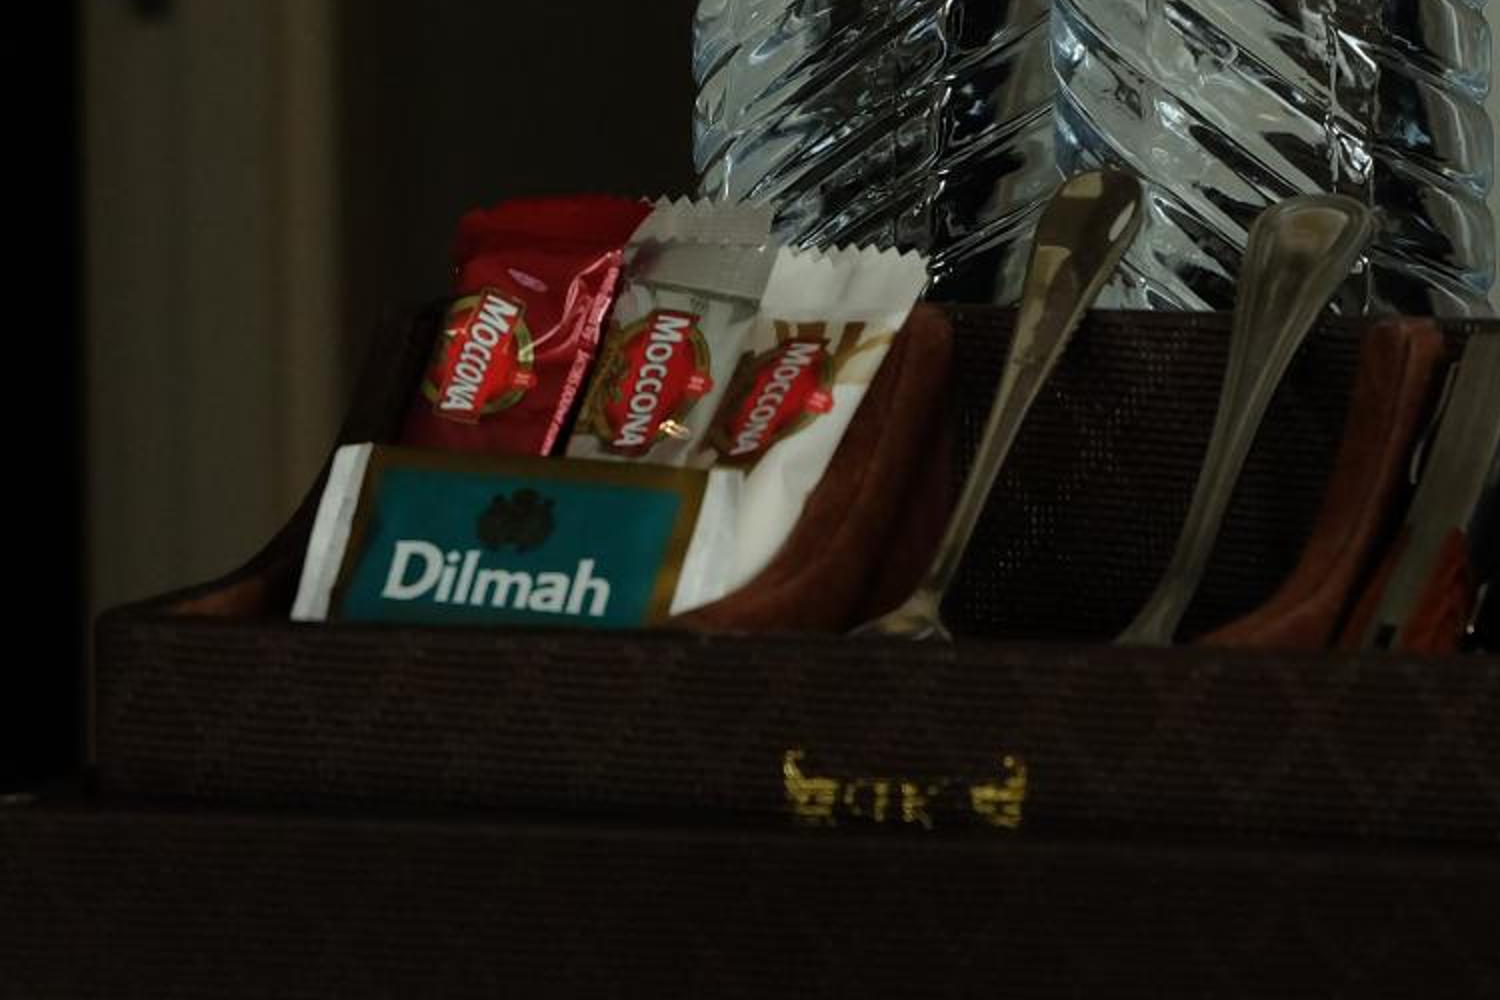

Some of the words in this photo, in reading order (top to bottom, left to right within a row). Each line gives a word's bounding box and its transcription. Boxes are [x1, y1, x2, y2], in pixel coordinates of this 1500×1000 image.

[440, 295, 519, 411] MOCCONA
[613, 314, 690, 447] MOCCONA
[729, 343, 822, 456] MOCCONA
[382, 540, 611, 618] Dilmah
